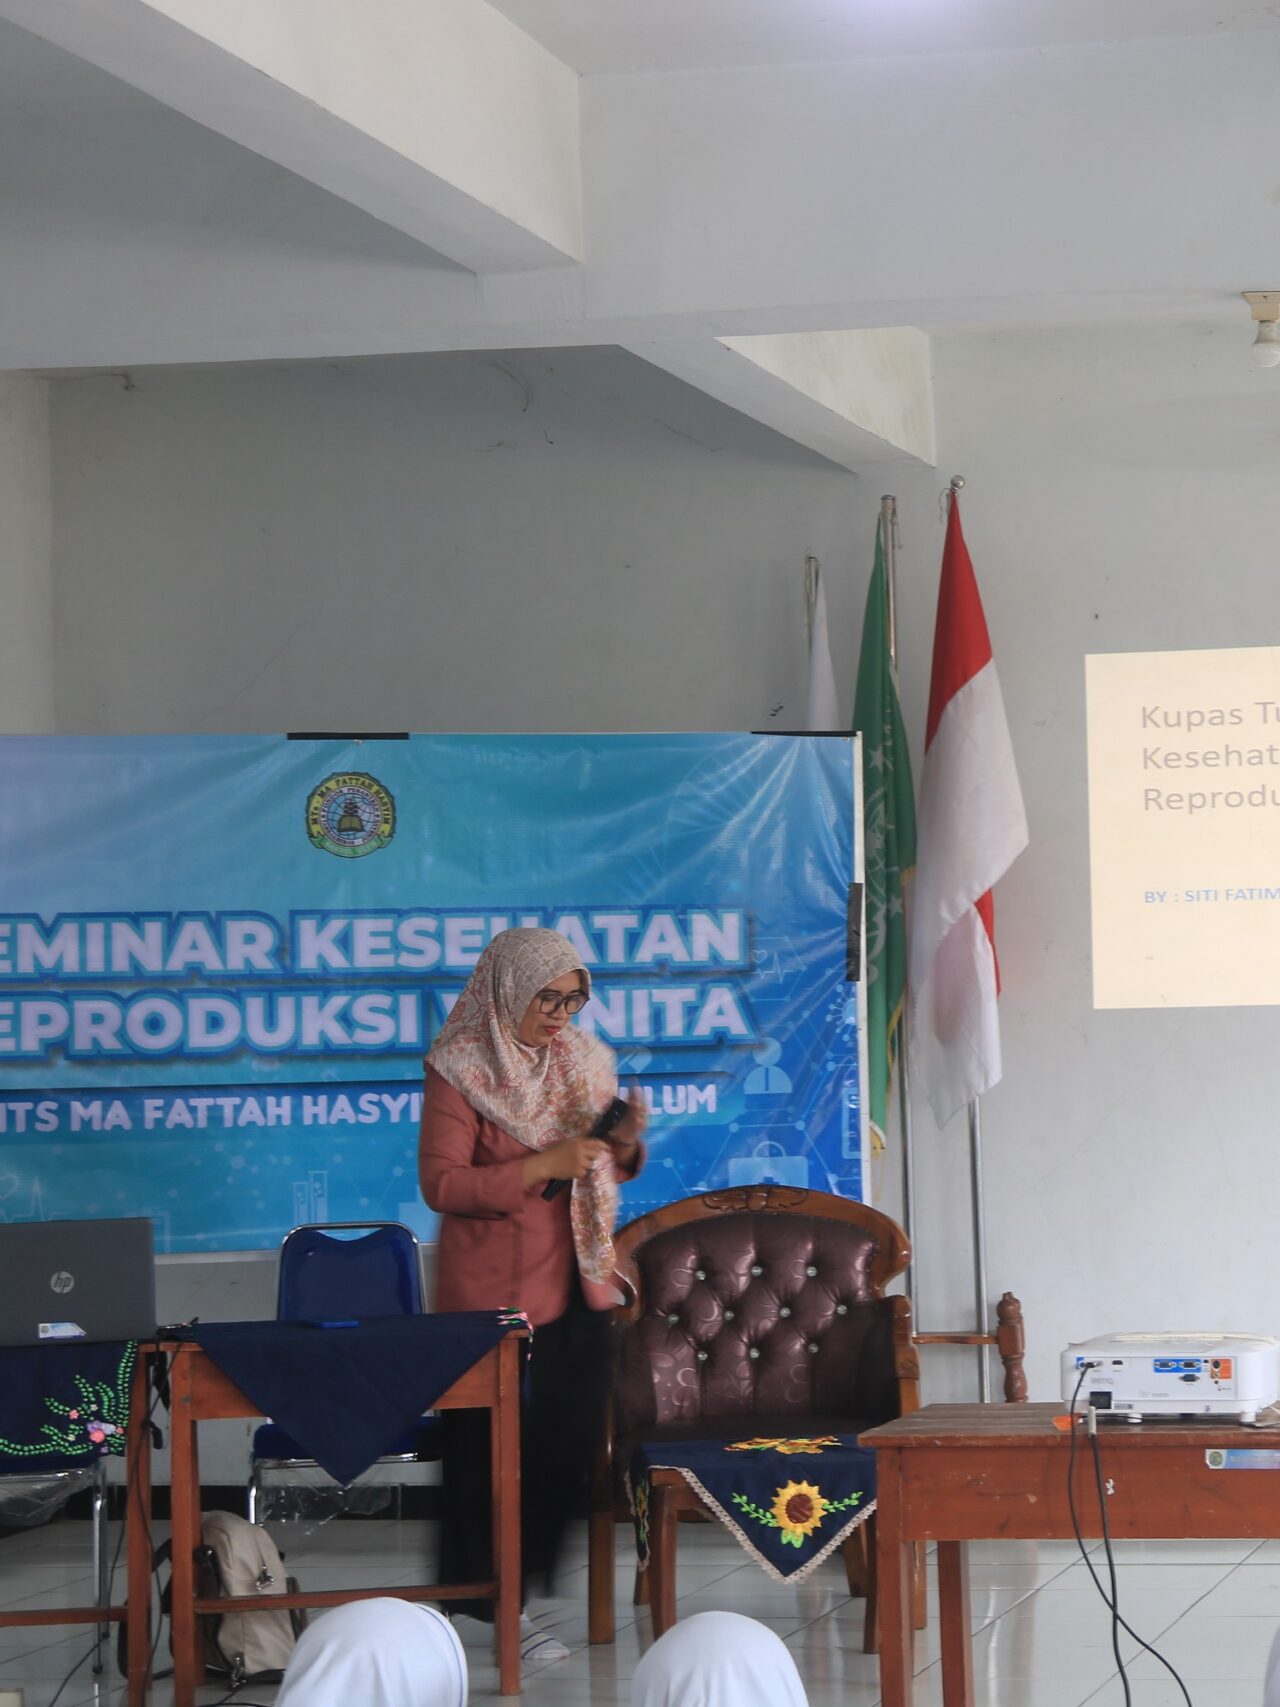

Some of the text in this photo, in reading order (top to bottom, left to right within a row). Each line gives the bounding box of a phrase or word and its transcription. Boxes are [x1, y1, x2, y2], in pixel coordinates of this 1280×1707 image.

[1141, 705, 1243, 731] Kupas
[1144, 890, 1167, 904] BY
[1185, 889, 1218, 902] SITI
[0, 1101, 59, 1133] TS
[70, 1100, 132, 1132] MA
[144, 1096, 292, 1130] FATTAH
[303, 1092, 425, 1126] HASYI
[51, 1271, 75, 1294] hp
